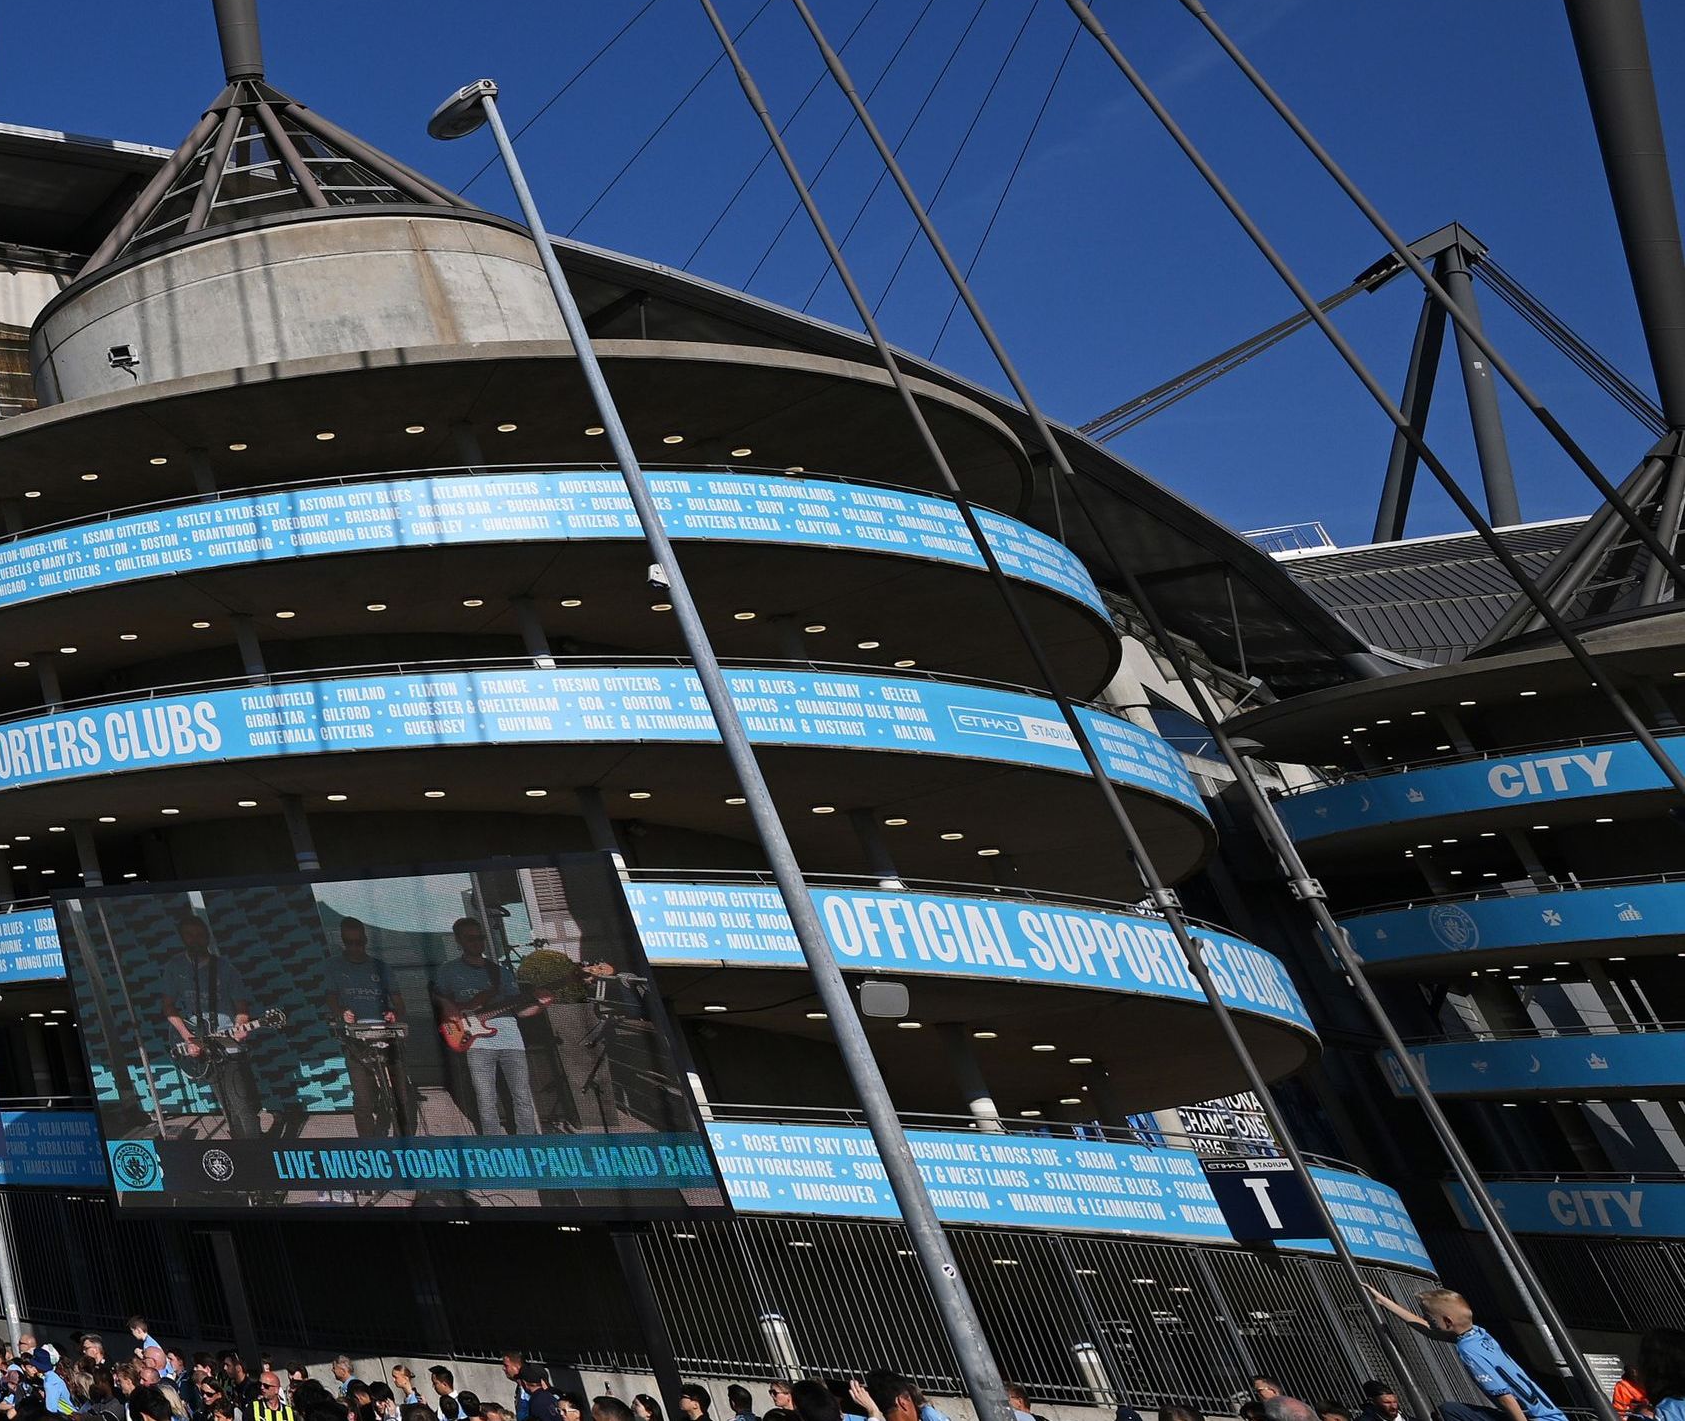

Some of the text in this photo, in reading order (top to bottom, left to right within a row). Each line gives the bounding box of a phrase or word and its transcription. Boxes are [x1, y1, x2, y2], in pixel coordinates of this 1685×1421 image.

[300, 488, 414, 511] ASTORIA CITY BLUES
[687, 498, 784, 514] BULGARIA BURY
[83, 502, 279, 545] ASSAM CITYZENS ASTLEY TYLDESLEY
[796, 520, 841, 535] CLAYTON
[94, 522, 256, 559] BOLTON BOSTON BRANTWOOD
[115, 548, 192, 571] CHILTERN BLUES
[242, 686, 386, 710] FALLOWFIELD FINLAND
[814, 682, 860, 698] GALWAY
[623, 696, 672, 710] GORTON
[246, 706, 370, 728] GIBRALTAR GILFORD
[746, 717, 866, 736] HALIFAX DISTRICT
[959, 715, 1020, 732] ETIHAD
[105, 700, 222, 760] CLUBS
[321, 724, 374, 740] CITYZENS
[1487, 751, 1613, 798] CITY
[664, 890, 728, 906] MANIPUR
[663, 911, 754, 928] MILANO BLUE
[822, 894, 1027, 968] OFFICIAL
[742, 1134, 841, 1154] ROSE CITY SKY
[757, 1158, 836, 1178] YORKSHIRE
[990, 1146, 1195, 1176] MOSS SIDE SABAH SAINT LOUIS
[1207, 1161, 1246, 1170] ETIHAD
[791, 1183, 877, 1203] VANCOUVER
[1046, 1172, 1162, 1196] STALYBRIDGE BLUES
[1008, 1194, 1166, 1220] WARWICK LEAMINGTON
[1243, 1178, 1283, 1228] T
[1547, 1189, 1644, 1228] CITY
